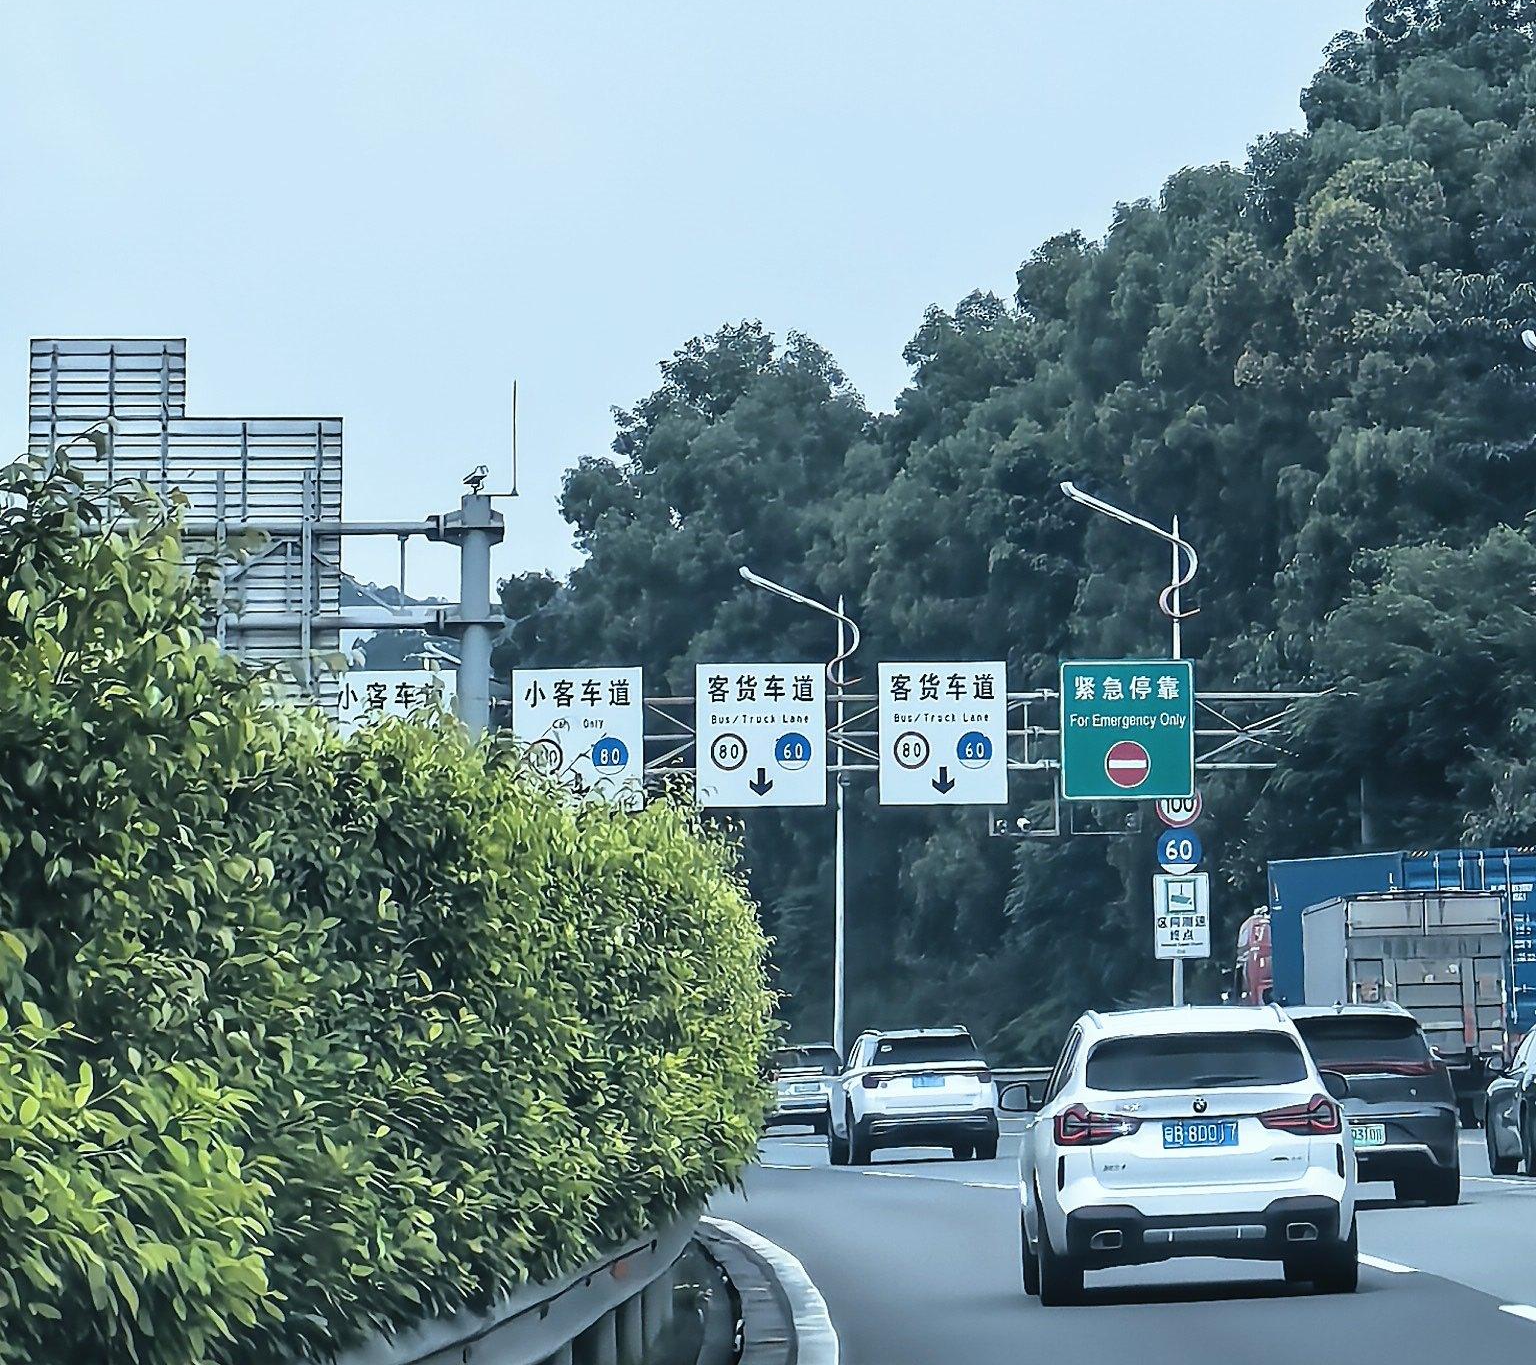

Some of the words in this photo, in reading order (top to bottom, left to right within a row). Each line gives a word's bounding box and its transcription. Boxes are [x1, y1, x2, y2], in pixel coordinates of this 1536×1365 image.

[524, 679, 631, 708] 小客车道
[708, 674, 814, 702] 客货车道
[890, 673, 994, 701] 客货车道
[1074, 676, 1180, 700] 紧急停靠
[782, 714, 809, 723] Lane
[963, 713, 989, 722] Lane
[1070, 714, 1088, 727] For
[1092, 713, 1156, 729] Emergency
[1160, 712, 1186, 728] Only
[600, 748, 620, 765] 80
[719, 744, 739, 759] 80
[783, 743, 803, 760] 60
[903, 742, 921, 758] 80
[965, 742, 985, 758] 60
[1165, 839, 1193, 861] 60
